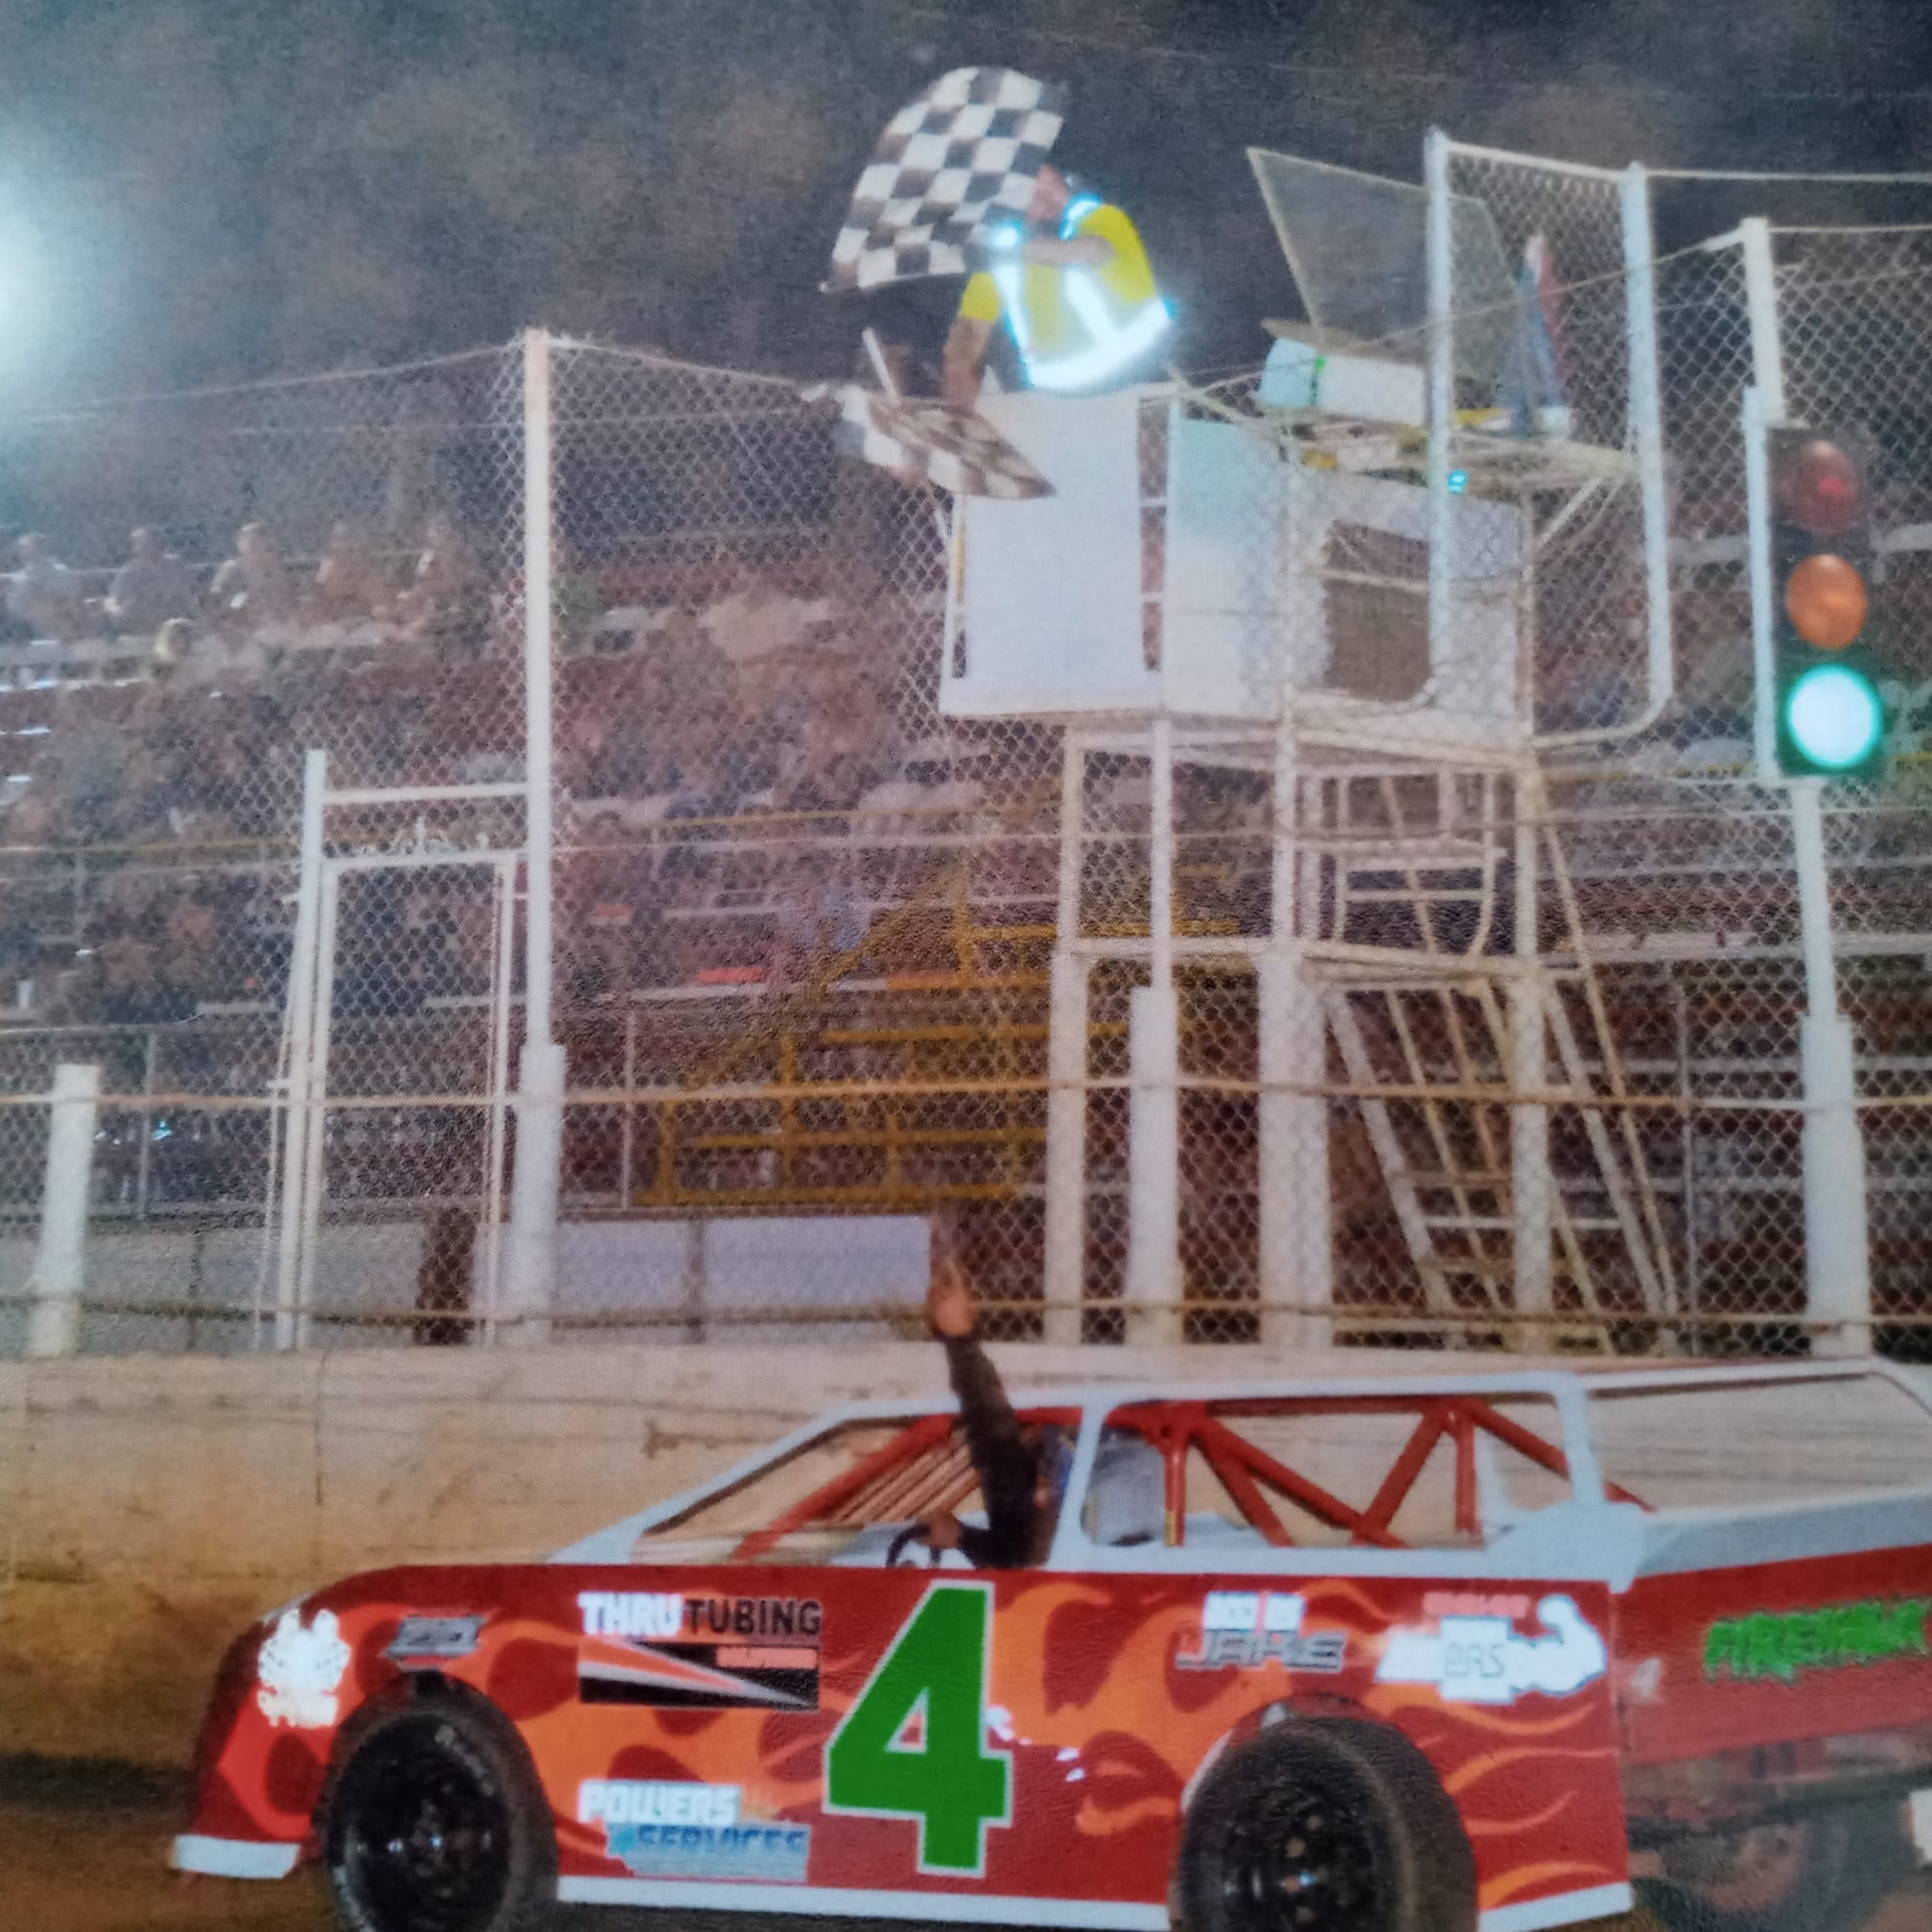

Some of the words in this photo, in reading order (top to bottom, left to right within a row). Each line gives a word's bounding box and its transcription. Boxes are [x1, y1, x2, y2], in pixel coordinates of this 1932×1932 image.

[577, 1592, 682, 1636] THRU
[687, 1598, 823, 1636] TUBING
[822, 1579, 1013, 1878] 4
[578, 1781, 741, 1824] POWERS
